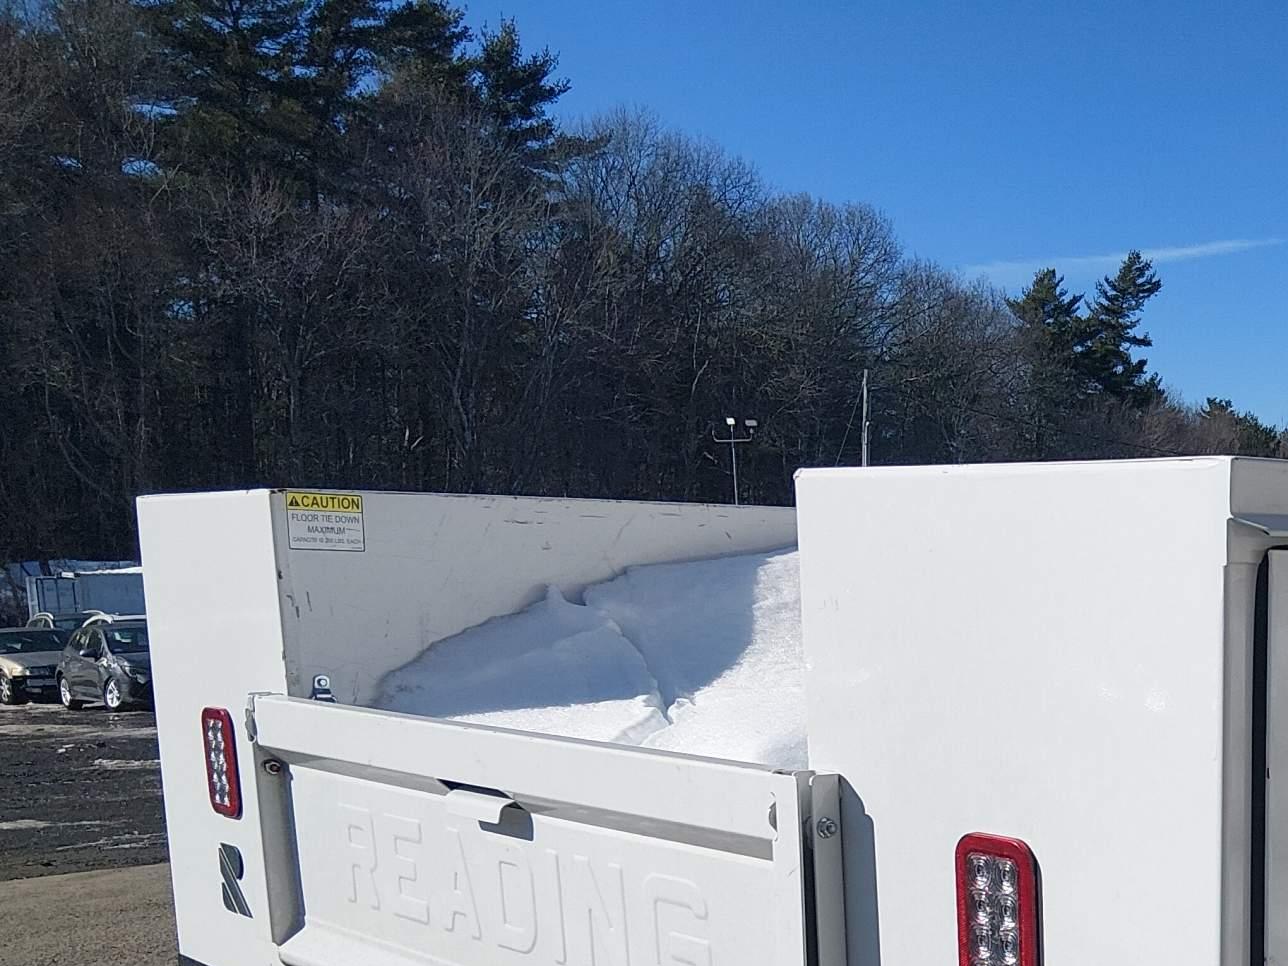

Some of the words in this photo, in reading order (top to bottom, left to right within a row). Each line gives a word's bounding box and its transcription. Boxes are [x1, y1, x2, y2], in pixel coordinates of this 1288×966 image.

[301, 495, 360, 510] CAUTION
[291, 513, 319, 523] FLOOR
[320, 514, 334, 523] TIE
[335, 515, 360, 524] DOWN
[307, 525, 345, 535] MAXIMUM
